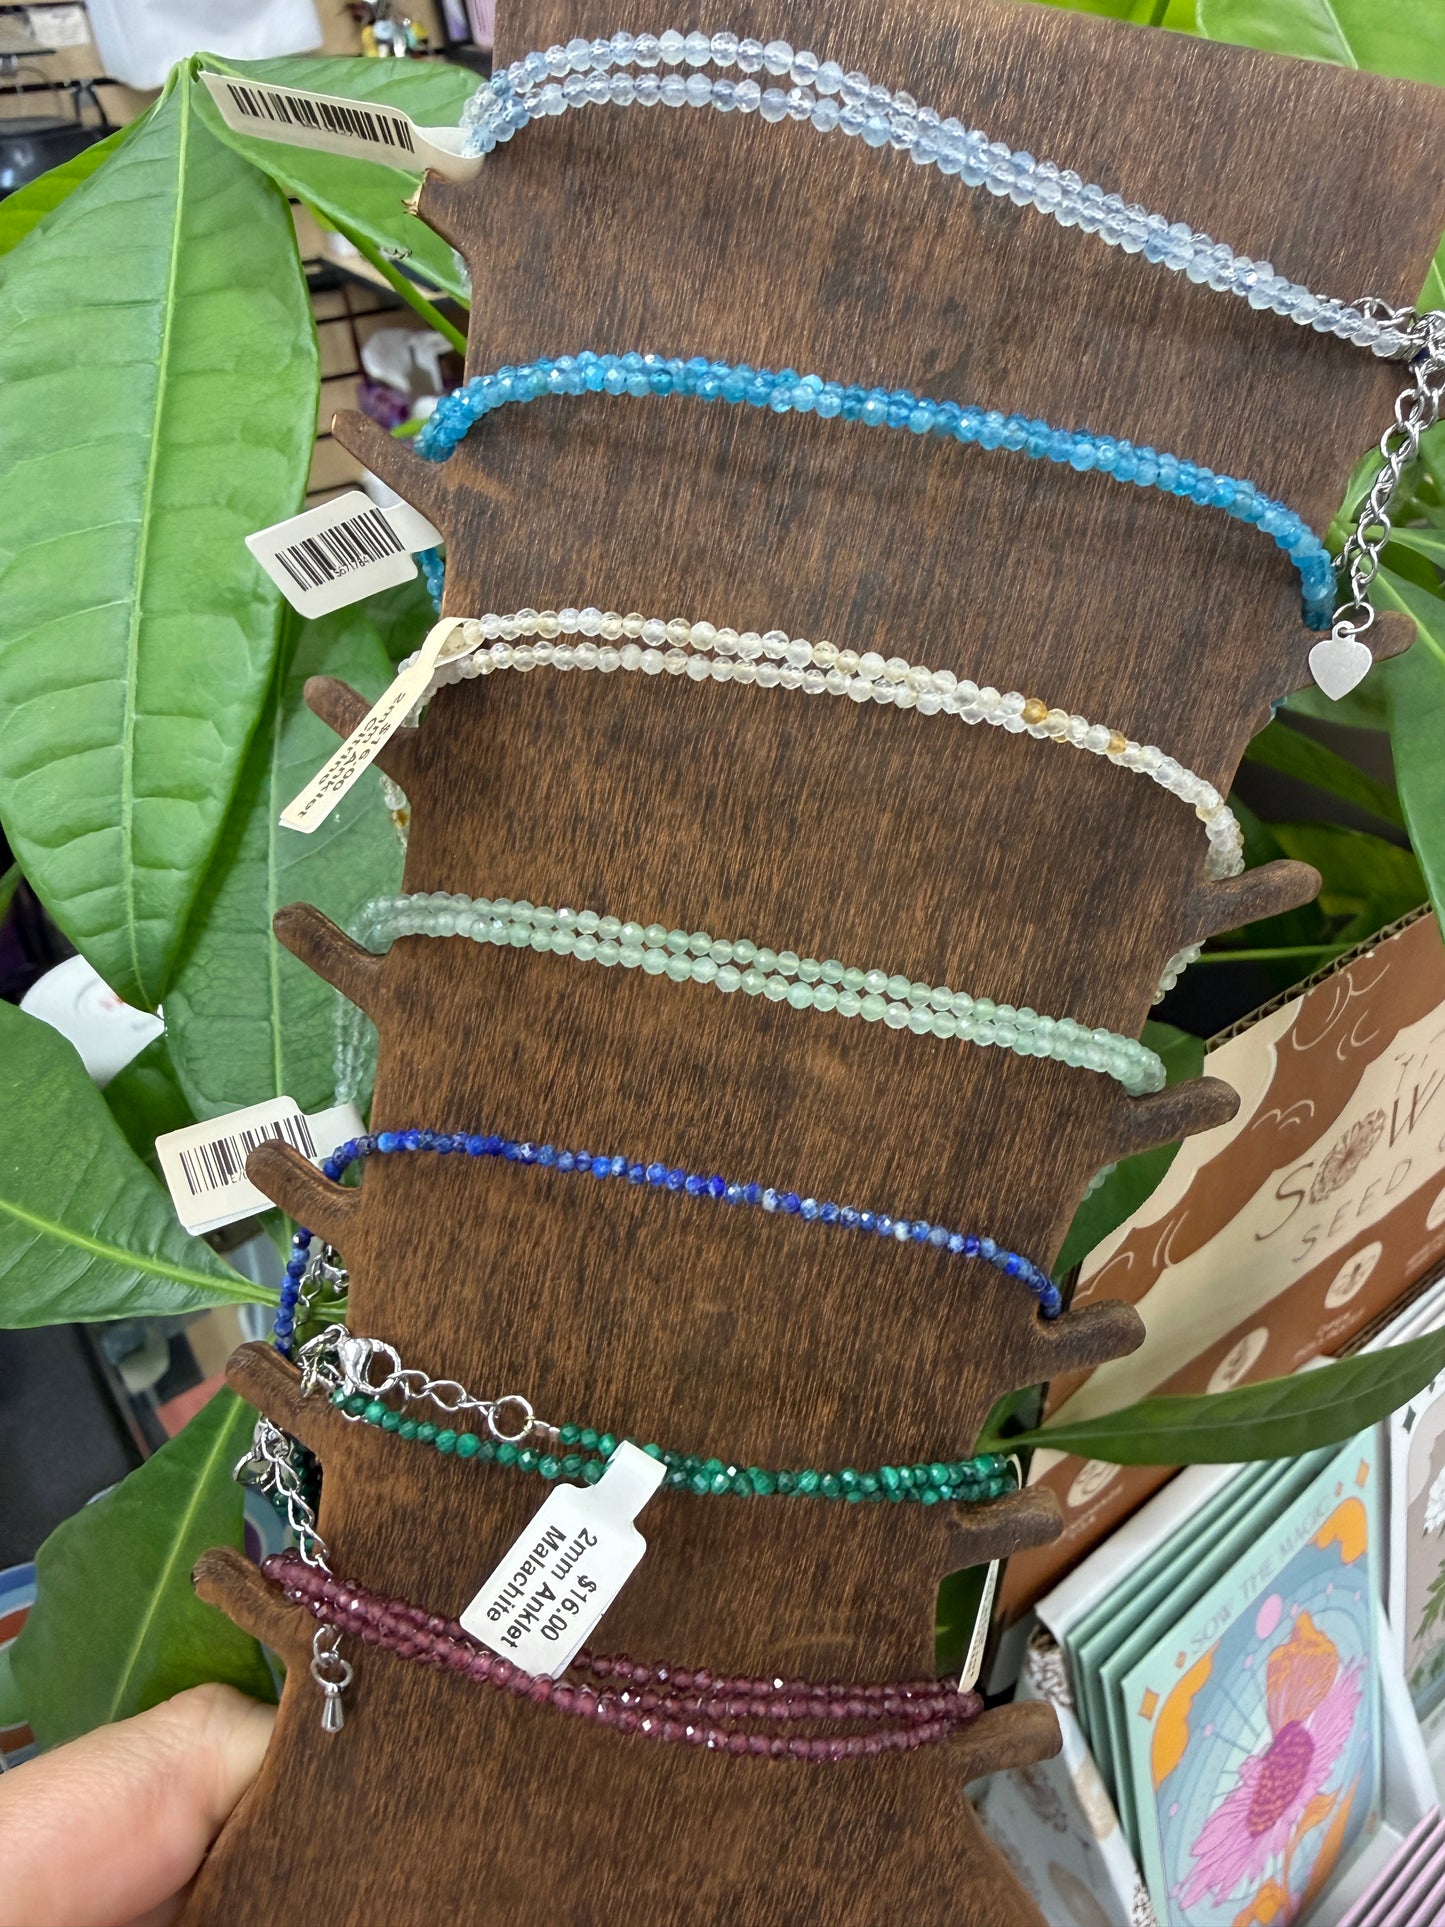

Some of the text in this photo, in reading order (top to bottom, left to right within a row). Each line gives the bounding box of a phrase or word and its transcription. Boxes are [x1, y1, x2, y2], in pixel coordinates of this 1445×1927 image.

[297, 693, 406, 818] 2mm Anklet
[318, 717, 377, 785] Citrine
[333, 723, 391, 791] $16.00
[1292, 1158, 1412, 1263] SEED
[486, 1525, 567, 1621] Malachite
[500, 1527, 598, 1648] 2mm Anklet
[540, 1575, 597, 1641] $16.00
[1192, 1598, 1233, 1655] SOW
[1239, 1559, 1273, 1598] THE
